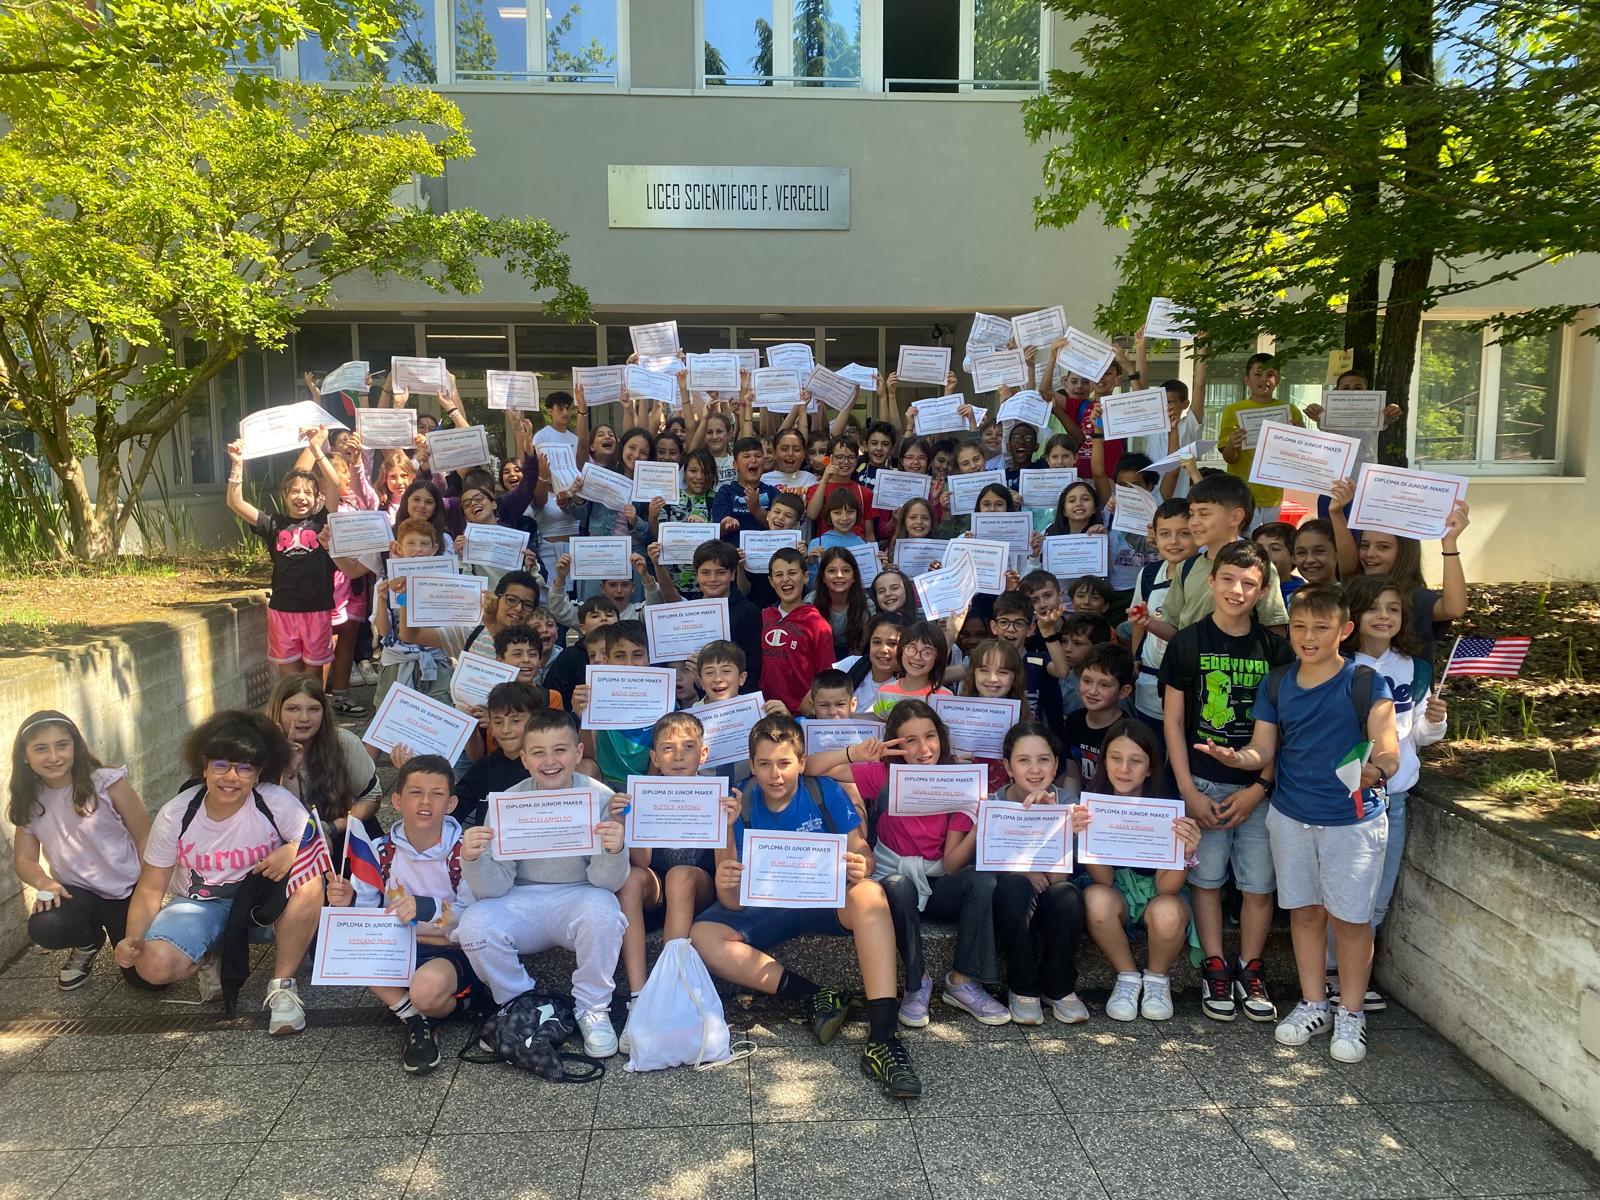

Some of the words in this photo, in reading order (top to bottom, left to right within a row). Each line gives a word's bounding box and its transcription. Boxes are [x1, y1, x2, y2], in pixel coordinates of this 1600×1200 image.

[646, 184, 680, 210] LICEO
[684, 184, 758, 210] SCIENTIFICO
[762, 184, 772, 210] F.
[776, 184, 829, 211] VERCELLI
[1274, 435, 1296, 444] DIPLOMA
[1304, 441, 1322, 449] JUNIOR
[1323, 444, 1342, 453] MAKER
[1374, 477, 1399, 486] DIPLOMA
[400, 698, 420, 711] DIPLOMA
[426, 710, 443, 721] JUNIOR
[442, 718, 460, 729] MAKER
[176, 832, 276, 872] Kuromi
